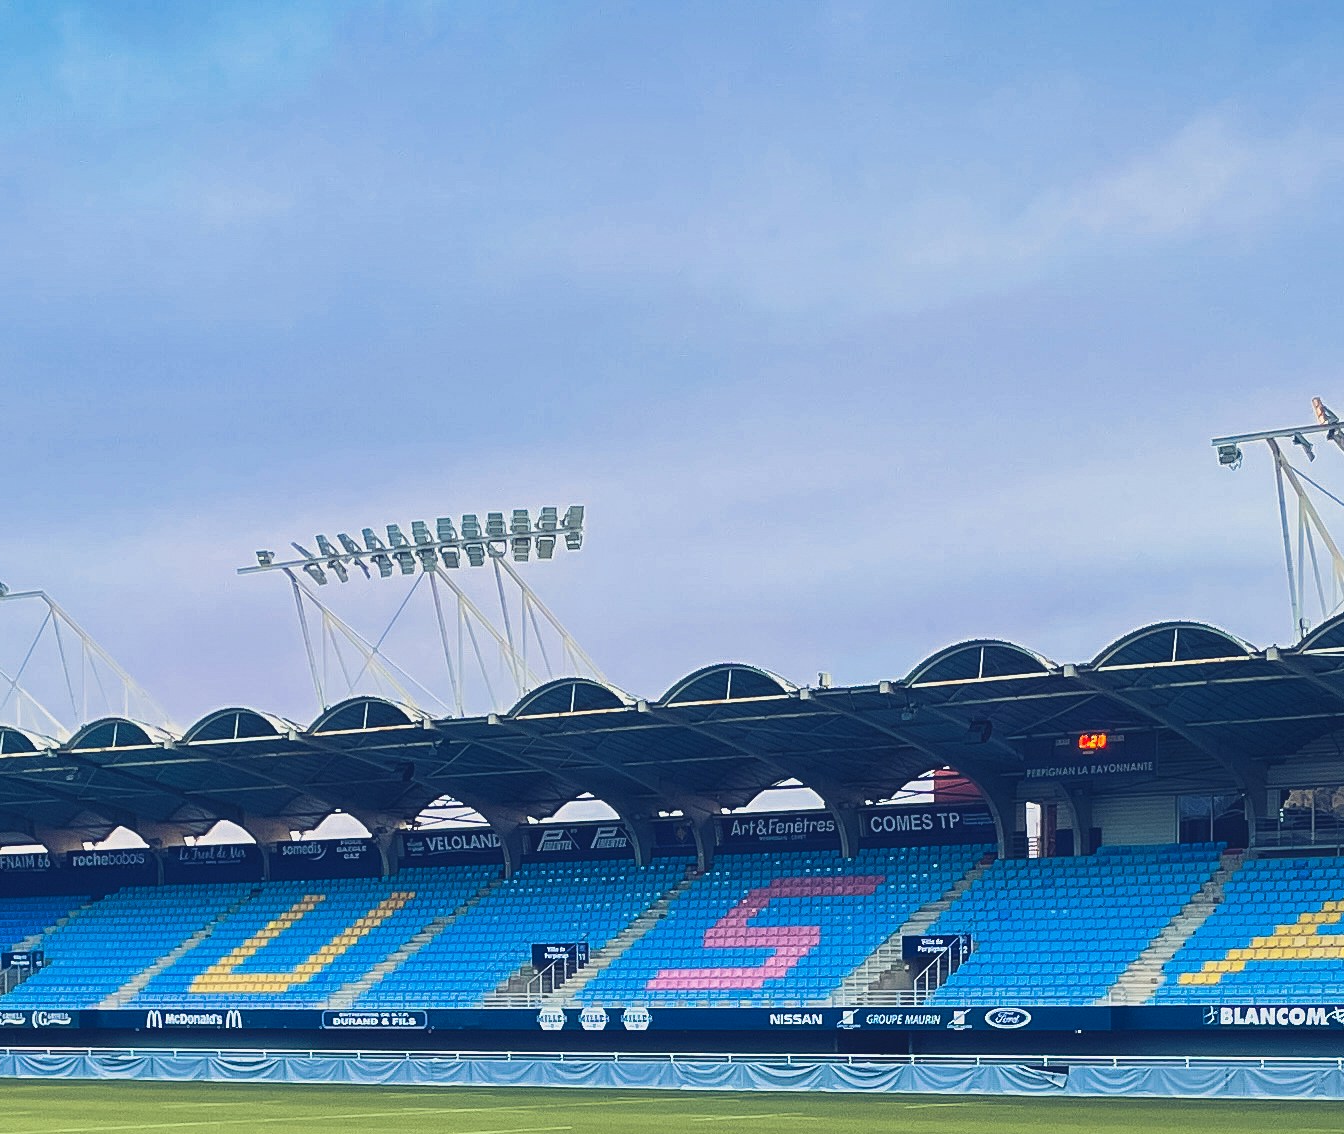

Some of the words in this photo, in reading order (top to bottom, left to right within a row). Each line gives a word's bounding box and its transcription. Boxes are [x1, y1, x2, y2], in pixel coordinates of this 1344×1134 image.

[1027, 766, 1076, 778] PERPIGNAN
[1078, 765, 1088, 775] LA
[1091, 762, 1153, 774] RAYONNANTE
[731, 817, 835, 837] Art&Fenêtres
[870, 814, 933, 833] COMES
[936, 812, 960, 828] TP
[282, 842, 322, 856] somedis
[426, 833, 501, 851] VELOLAND
[0, 854, 35, 870] FNAIM
[38, 854, 51, 868] 66
[72, 851, 145, 867] rochebobois
[165, 1013, 223, 1026] McDonald's
[332, 1017, 378, 1026] DURAND
[381, 1017, 389, 1026] &
[391, 1017, 416, 1026] FILS
[769, 1013, 823, 1025] NISSAN
[866, 1014, 903, 1025] GROUPE
[904, 1014, 941, 1025] MAURIN
[1220, 1007, 1330, 1025] BLANCOM
